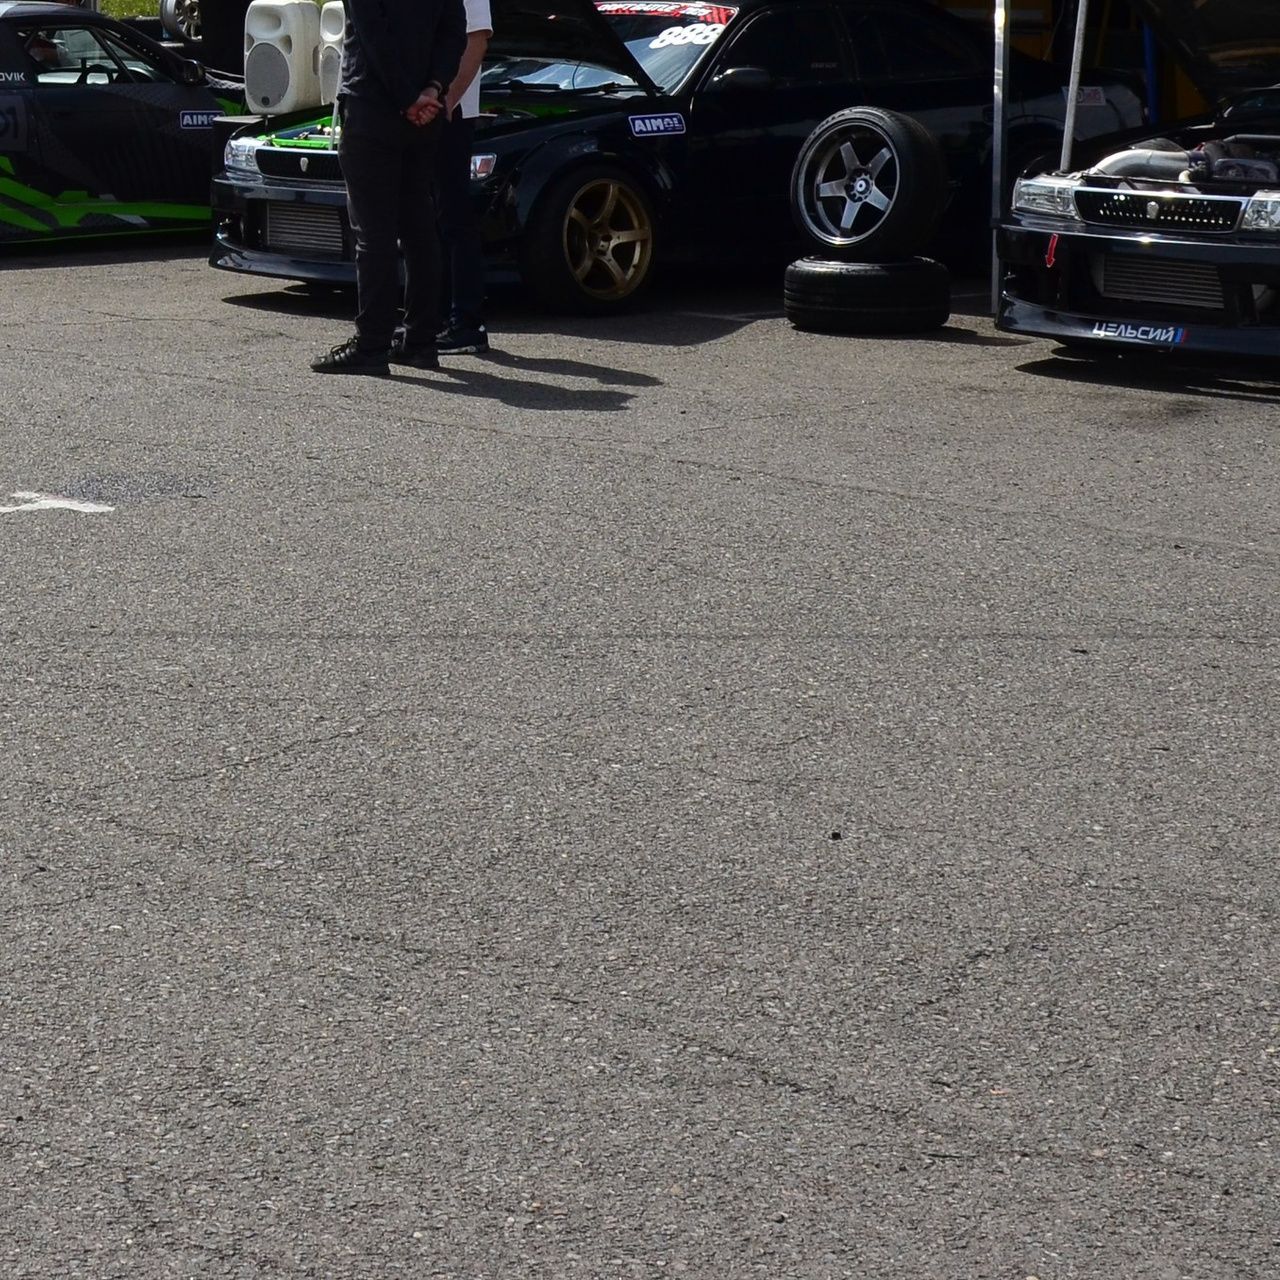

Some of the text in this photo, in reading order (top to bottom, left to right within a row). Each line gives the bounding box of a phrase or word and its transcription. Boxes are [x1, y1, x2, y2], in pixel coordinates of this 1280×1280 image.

[649, 23, 725, 49] 888
[634, 118, 684, 132] AIMOL
[1092, 322, 1175, 342] ЦЕЛЬСИЙ
